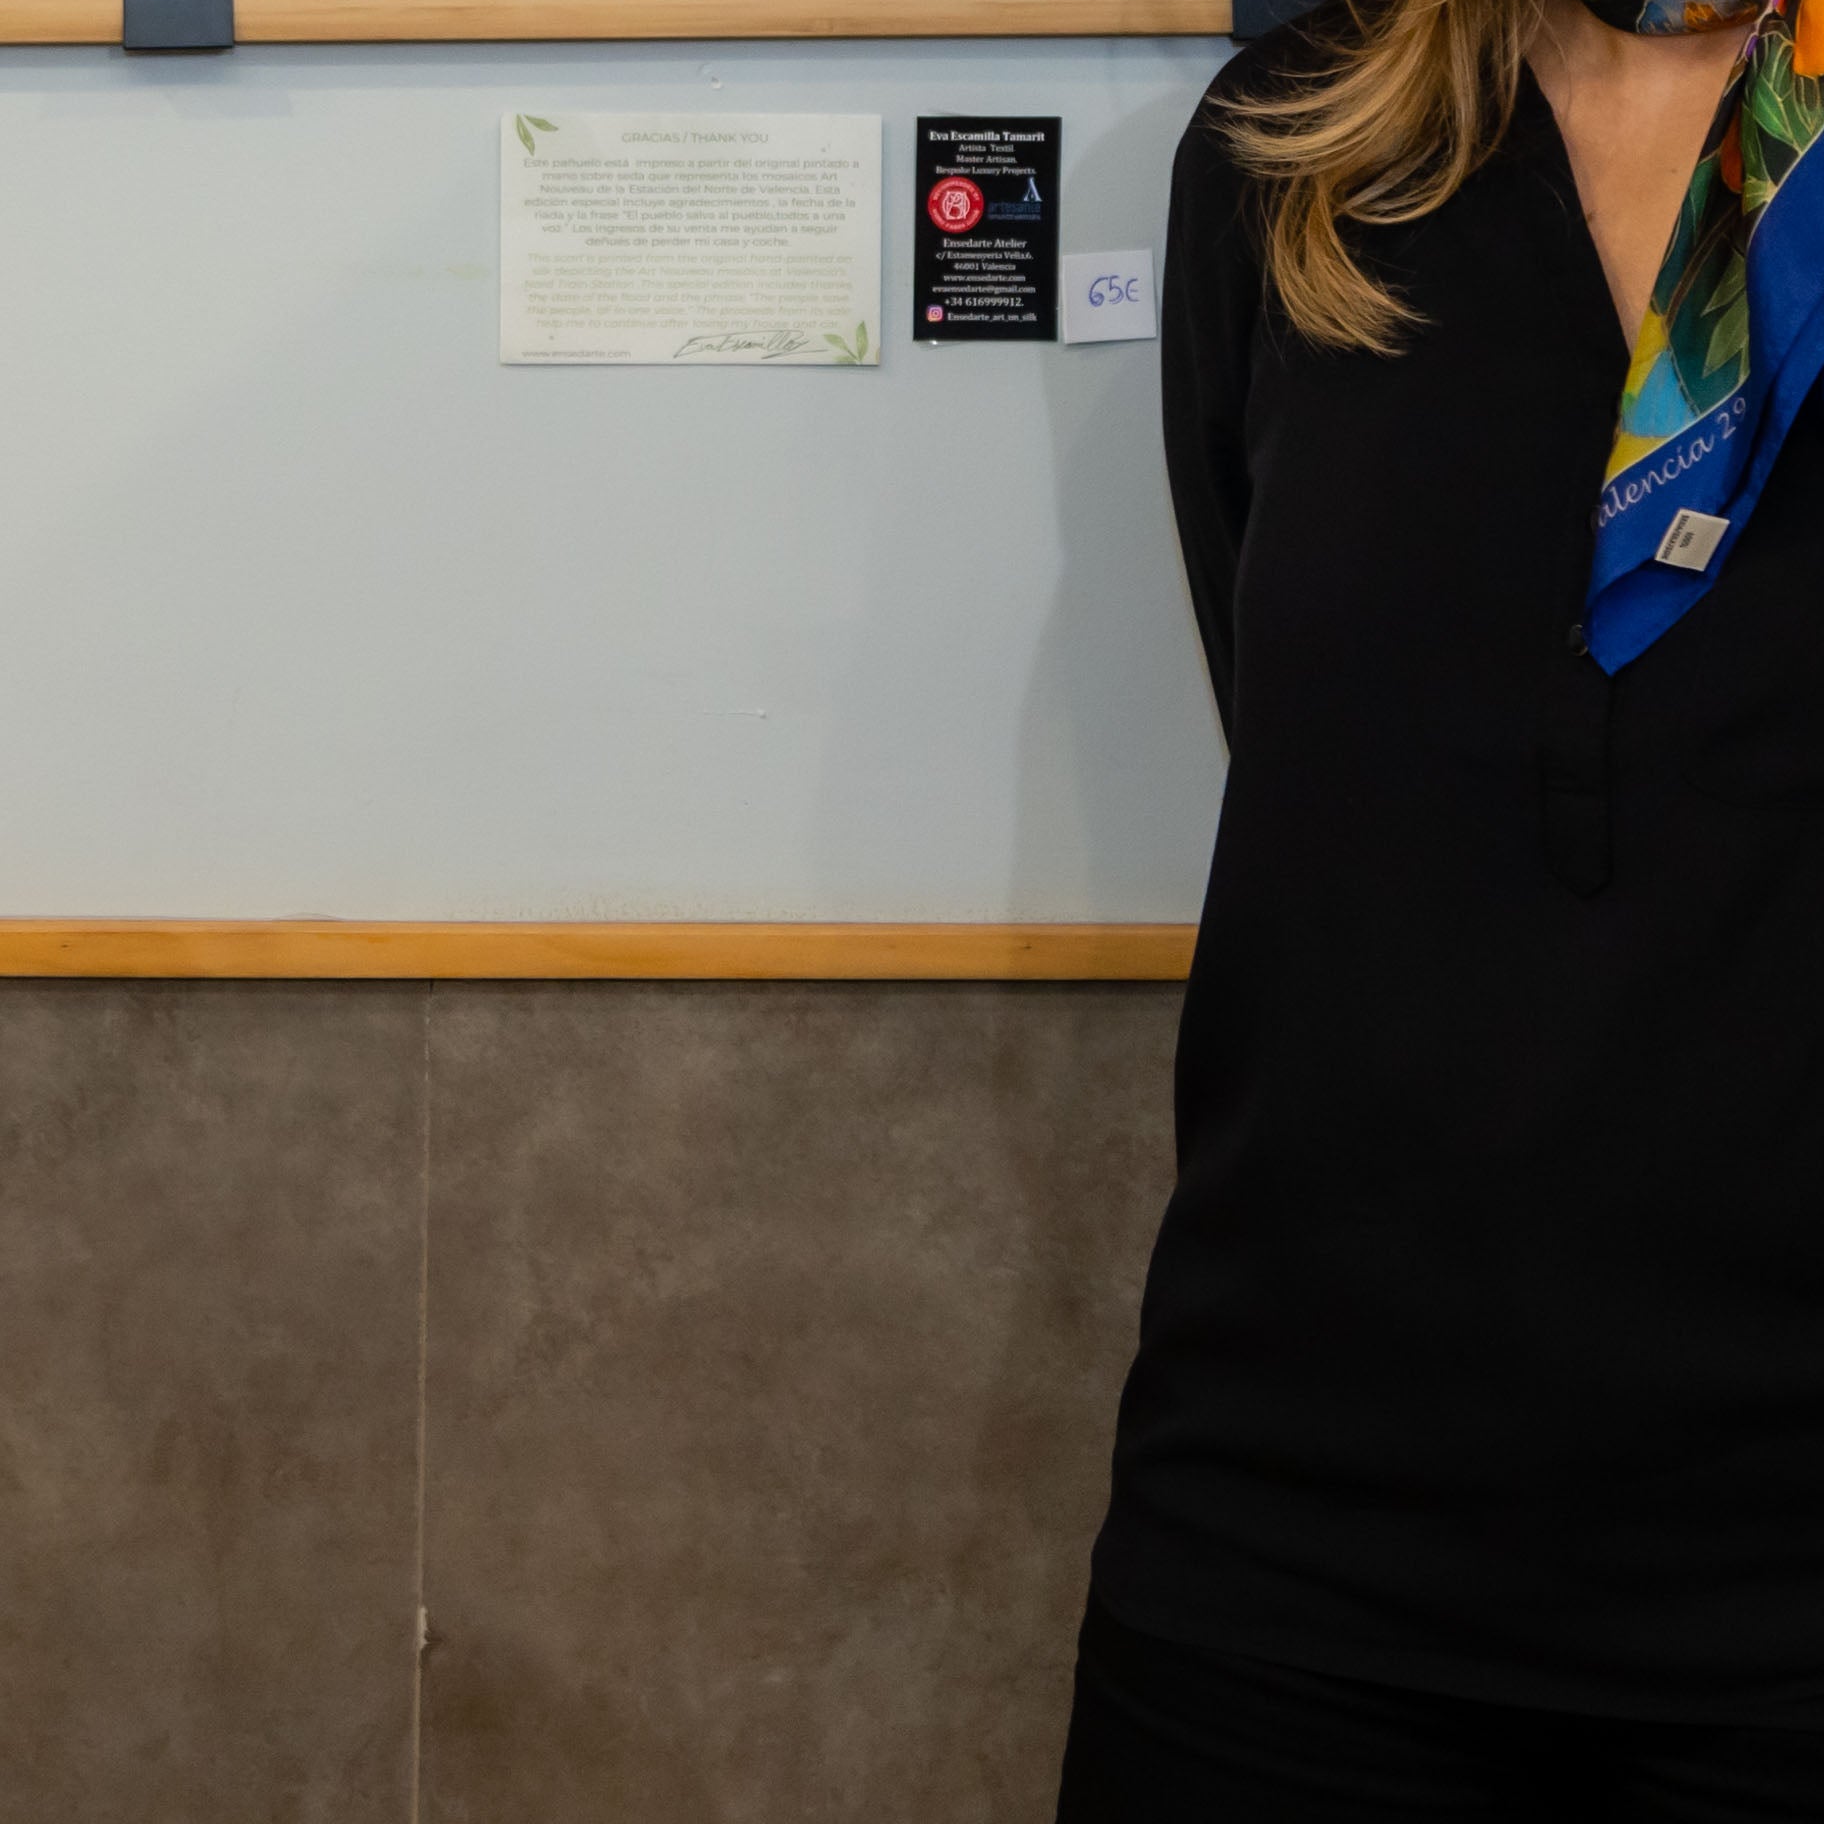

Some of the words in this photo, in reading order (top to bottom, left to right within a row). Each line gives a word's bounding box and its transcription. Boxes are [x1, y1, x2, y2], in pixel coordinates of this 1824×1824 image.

[621, 132, 680, 143] GRACIAS
[690, 132, 737, 143] THANK
[740, 132, 769, 143] YOU
[928, 130, 949, 141] Eva
[950, 130, 1001, 141] Escamilla
[1002, 131, 1045, 142] Tamarit
[1088, 274, 1141, 308] 65€
[1591, 433, 1716, 528] alencia
